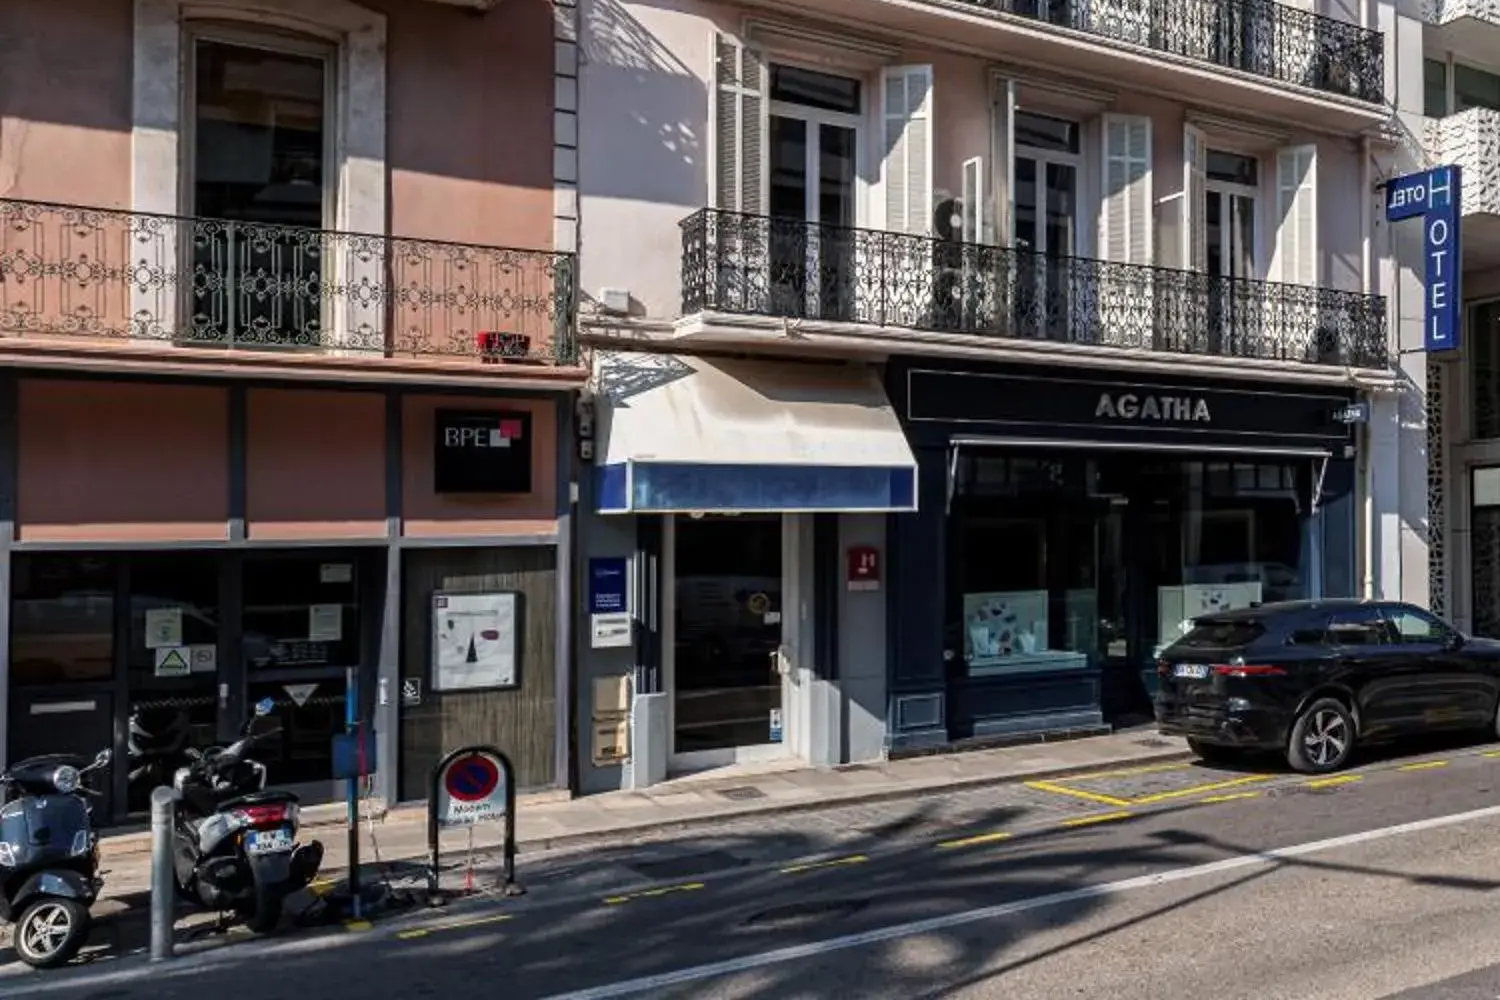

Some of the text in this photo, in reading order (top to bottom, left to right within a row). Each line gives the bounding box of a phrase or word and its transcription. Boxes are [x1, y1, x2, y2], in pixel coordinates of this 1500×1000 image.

[1429, 170, 1451, 341] HOTEL
[1095, 393, 1212, 422] AGATHA
[444, 426, 488, 448] BPE
